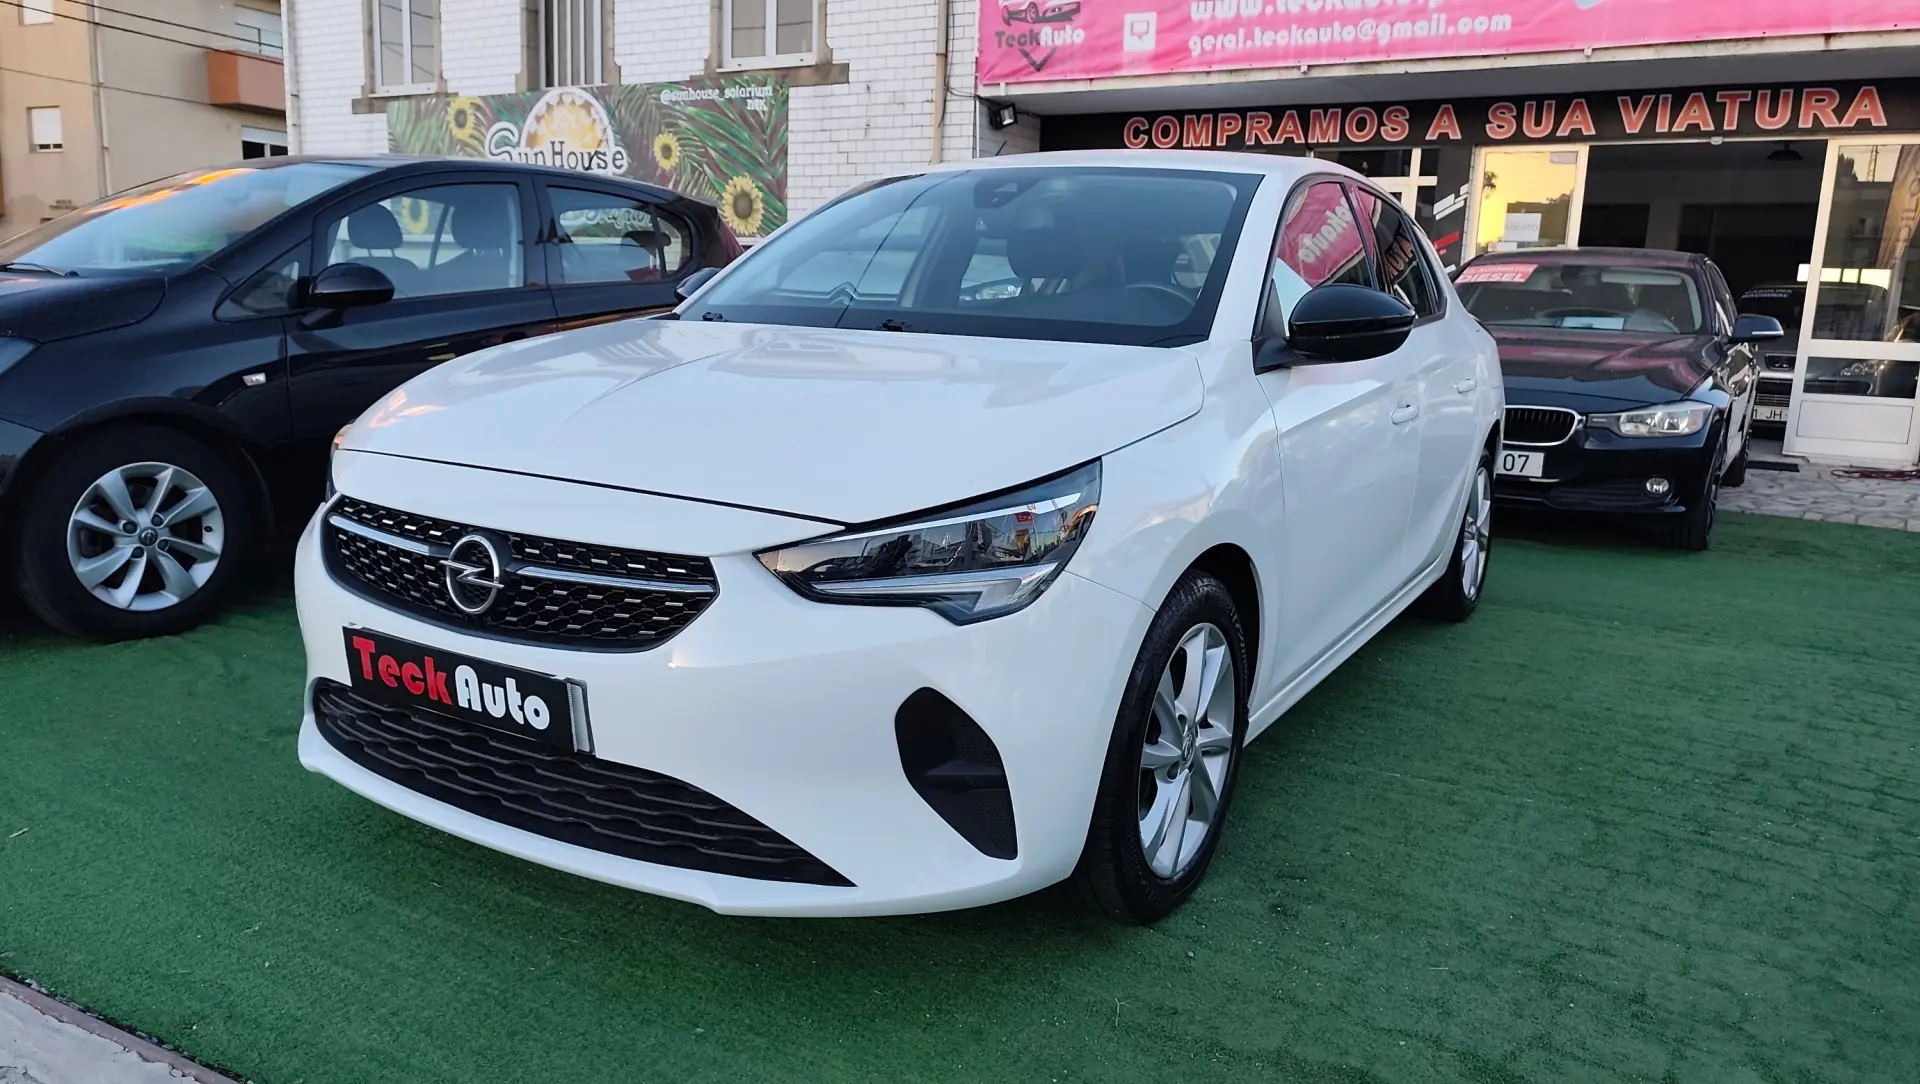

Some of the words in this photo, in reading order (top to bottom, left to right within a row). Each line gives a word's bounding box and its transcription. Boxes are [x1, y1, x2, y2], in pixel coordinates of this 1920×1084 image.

[995, 25, 1085, 49] TeckAuto
[1188, 13, 1512, 56] geral.teckauto@gmail.com
[1124, 106, 1409, 149] COMPRAMOS
[1425, 104, 1462, 141] A
[1485, 98, 1596, 140] SUA
[1617, 86, 1888, 134] VIATURA
[1455, 272, 1527, 283] DIESEL
[1503, 453, 1530, 473] 07
[352, 635, 550, 730] TeckAuto
